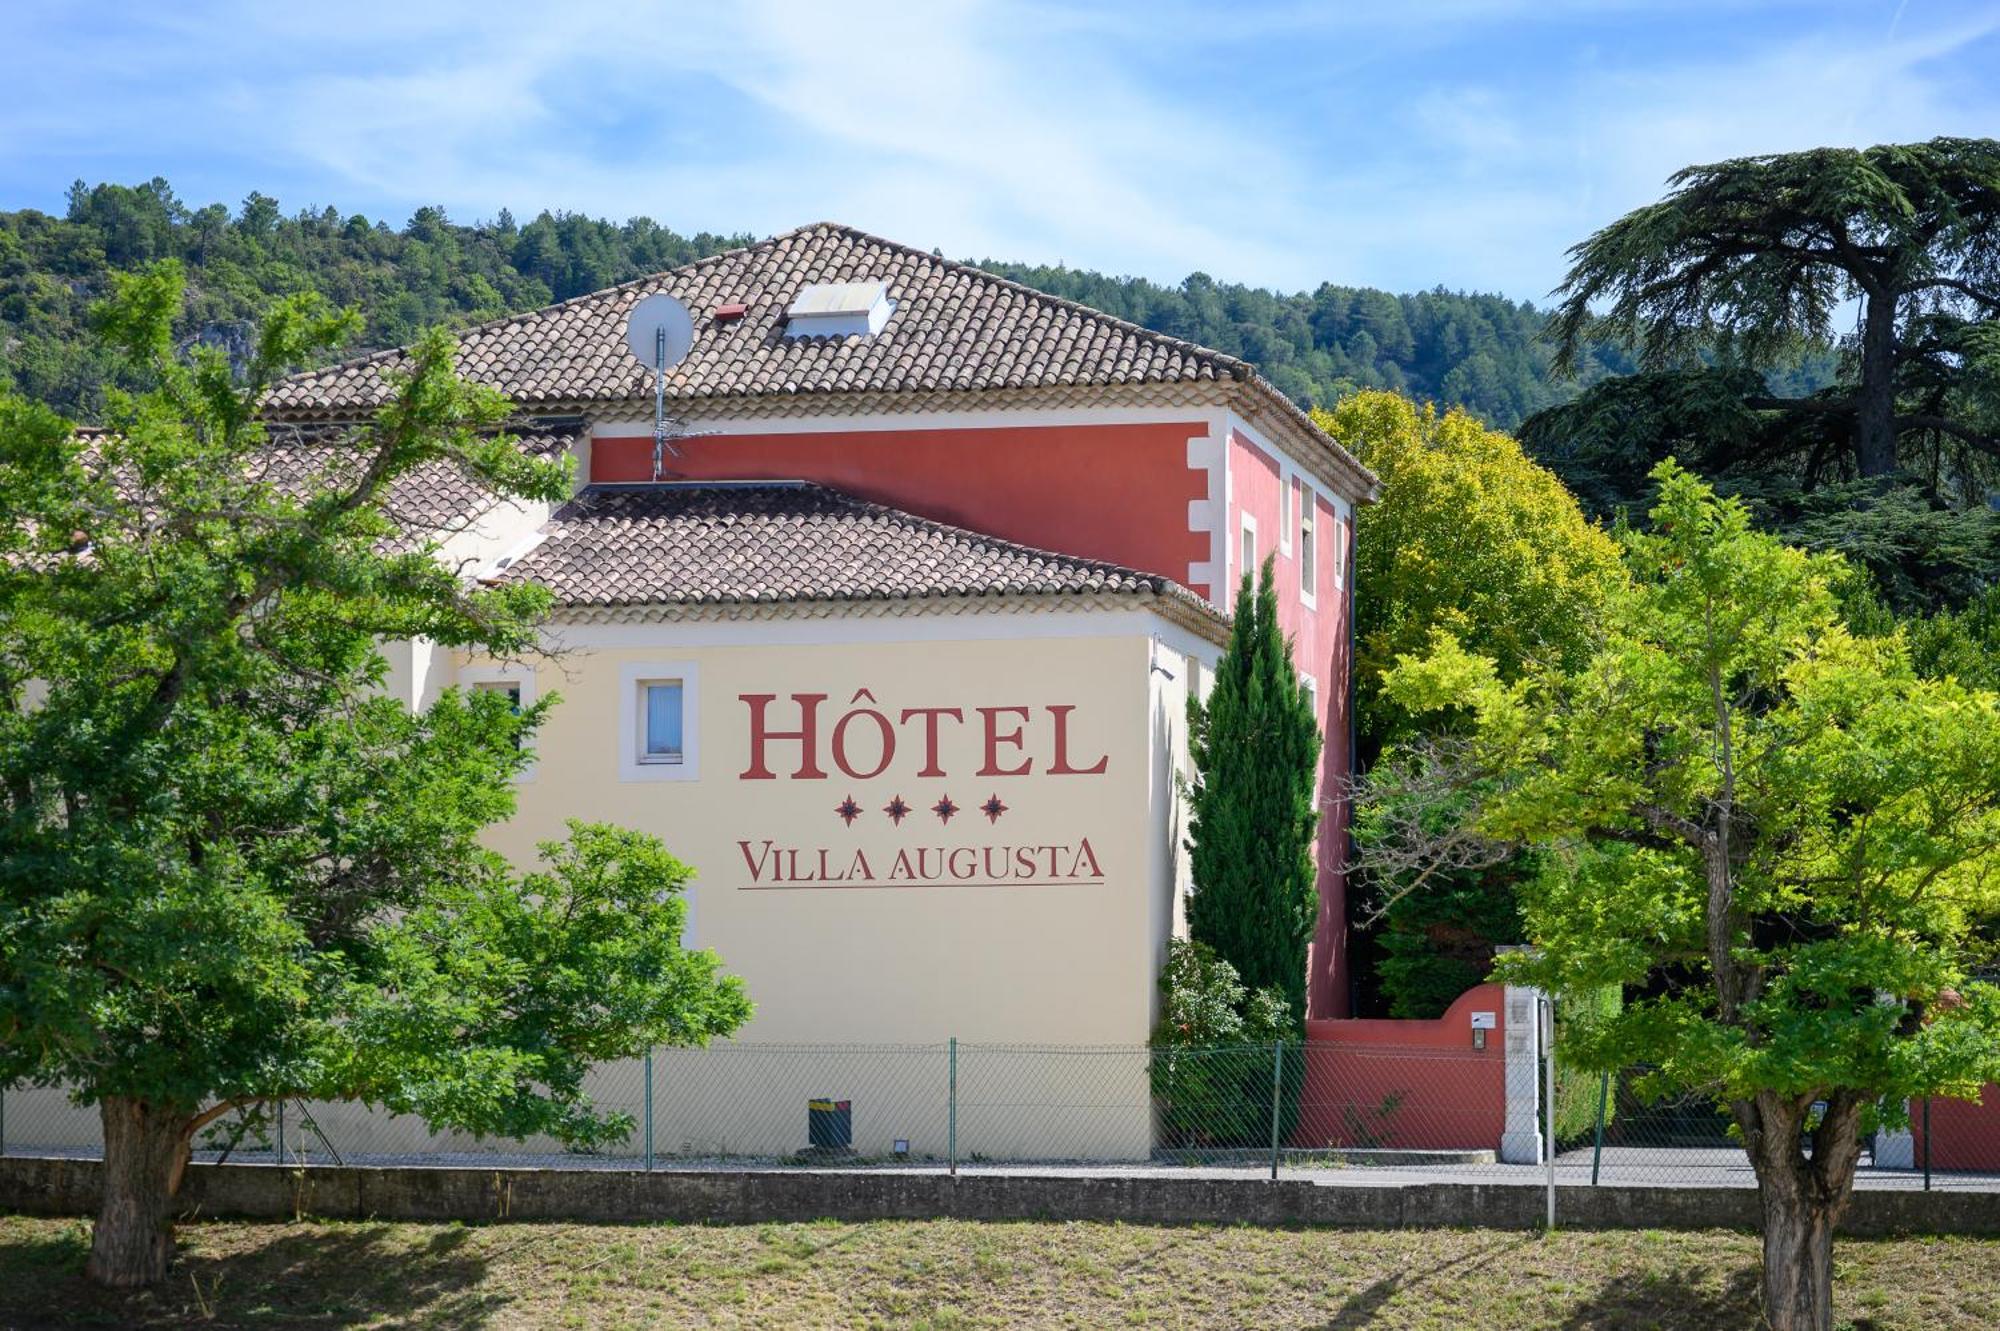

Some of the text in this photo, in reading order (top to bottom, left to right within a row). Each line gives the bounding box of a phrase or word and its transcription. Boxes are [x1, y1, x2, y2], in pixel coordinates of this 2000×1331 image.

[738, 687, 1110, 780] HÔTEL
[737, 837, 1104, 882] VILLA AUGUSTA
